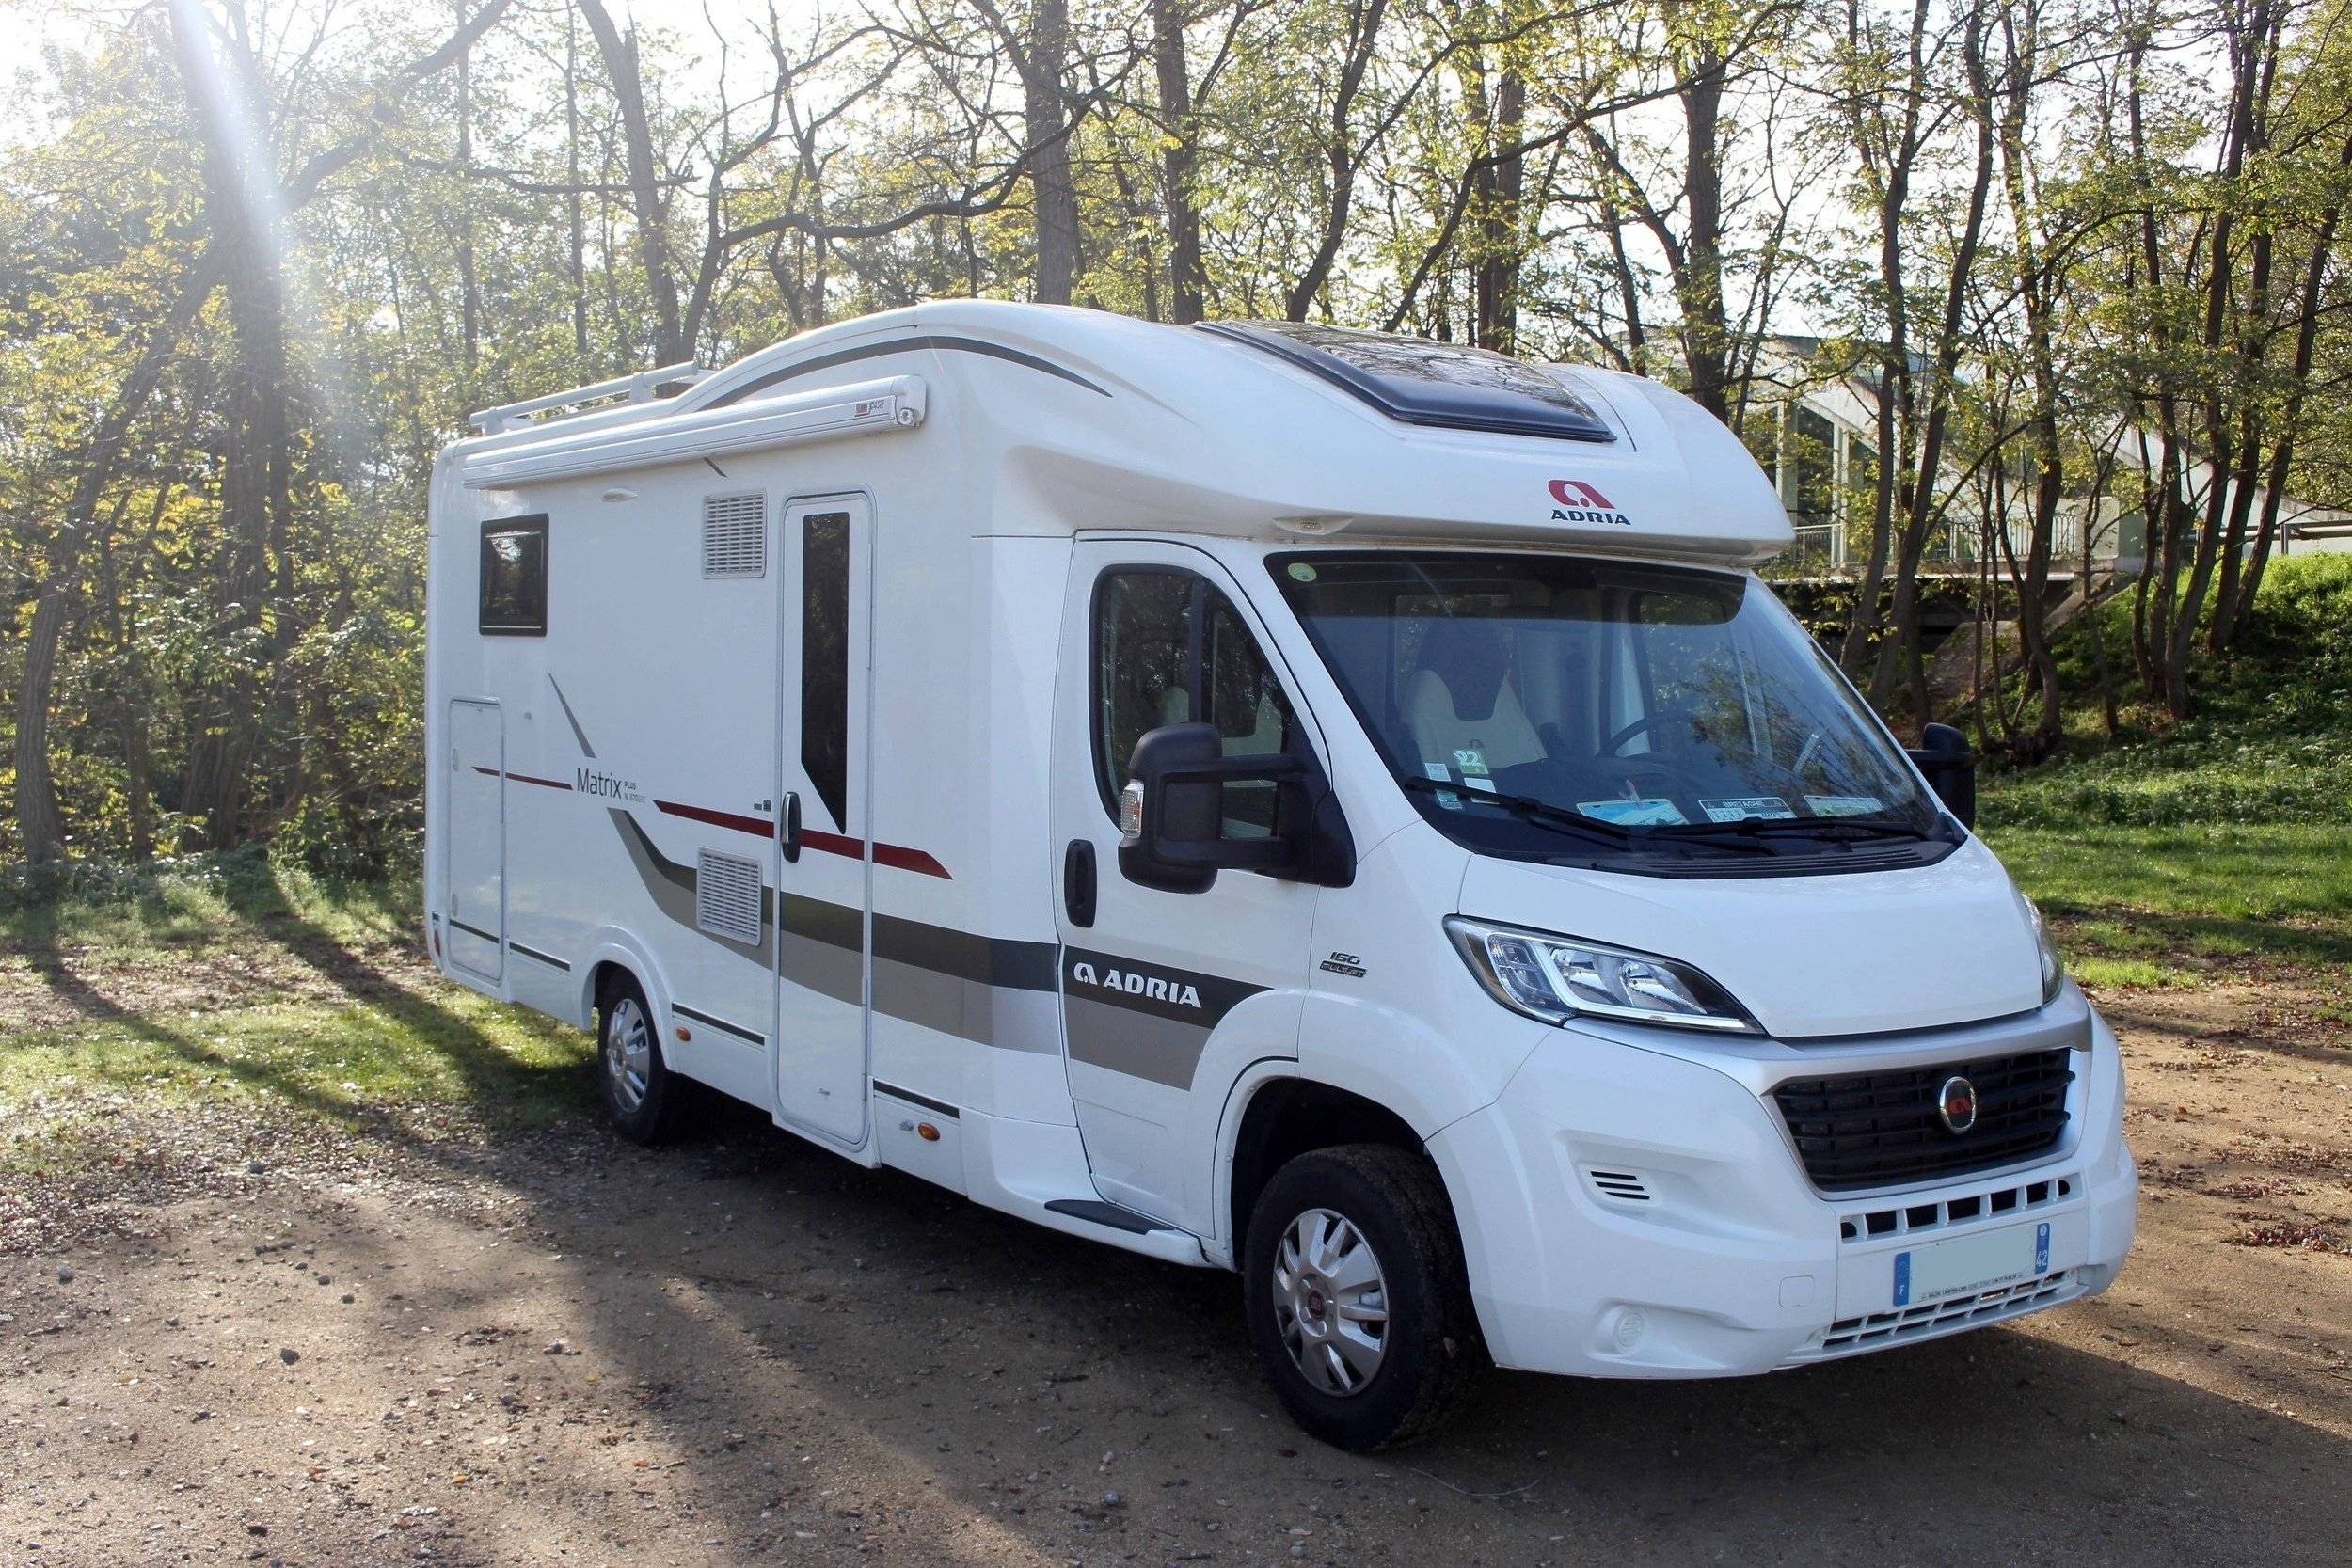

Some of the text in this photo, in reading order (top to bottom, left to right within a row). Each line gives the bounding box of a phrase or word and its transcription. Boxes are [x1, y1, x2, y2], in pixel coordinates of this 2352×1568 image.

[1551, 509, 1631, 526] ADRIA
[577, 767, 622, 800] Matrix
[1103, 969, 1202, 1009] ADRIA
[2036, 1249, 2048, 1268] 42
[1899, 1284, 1905, 1296] F
